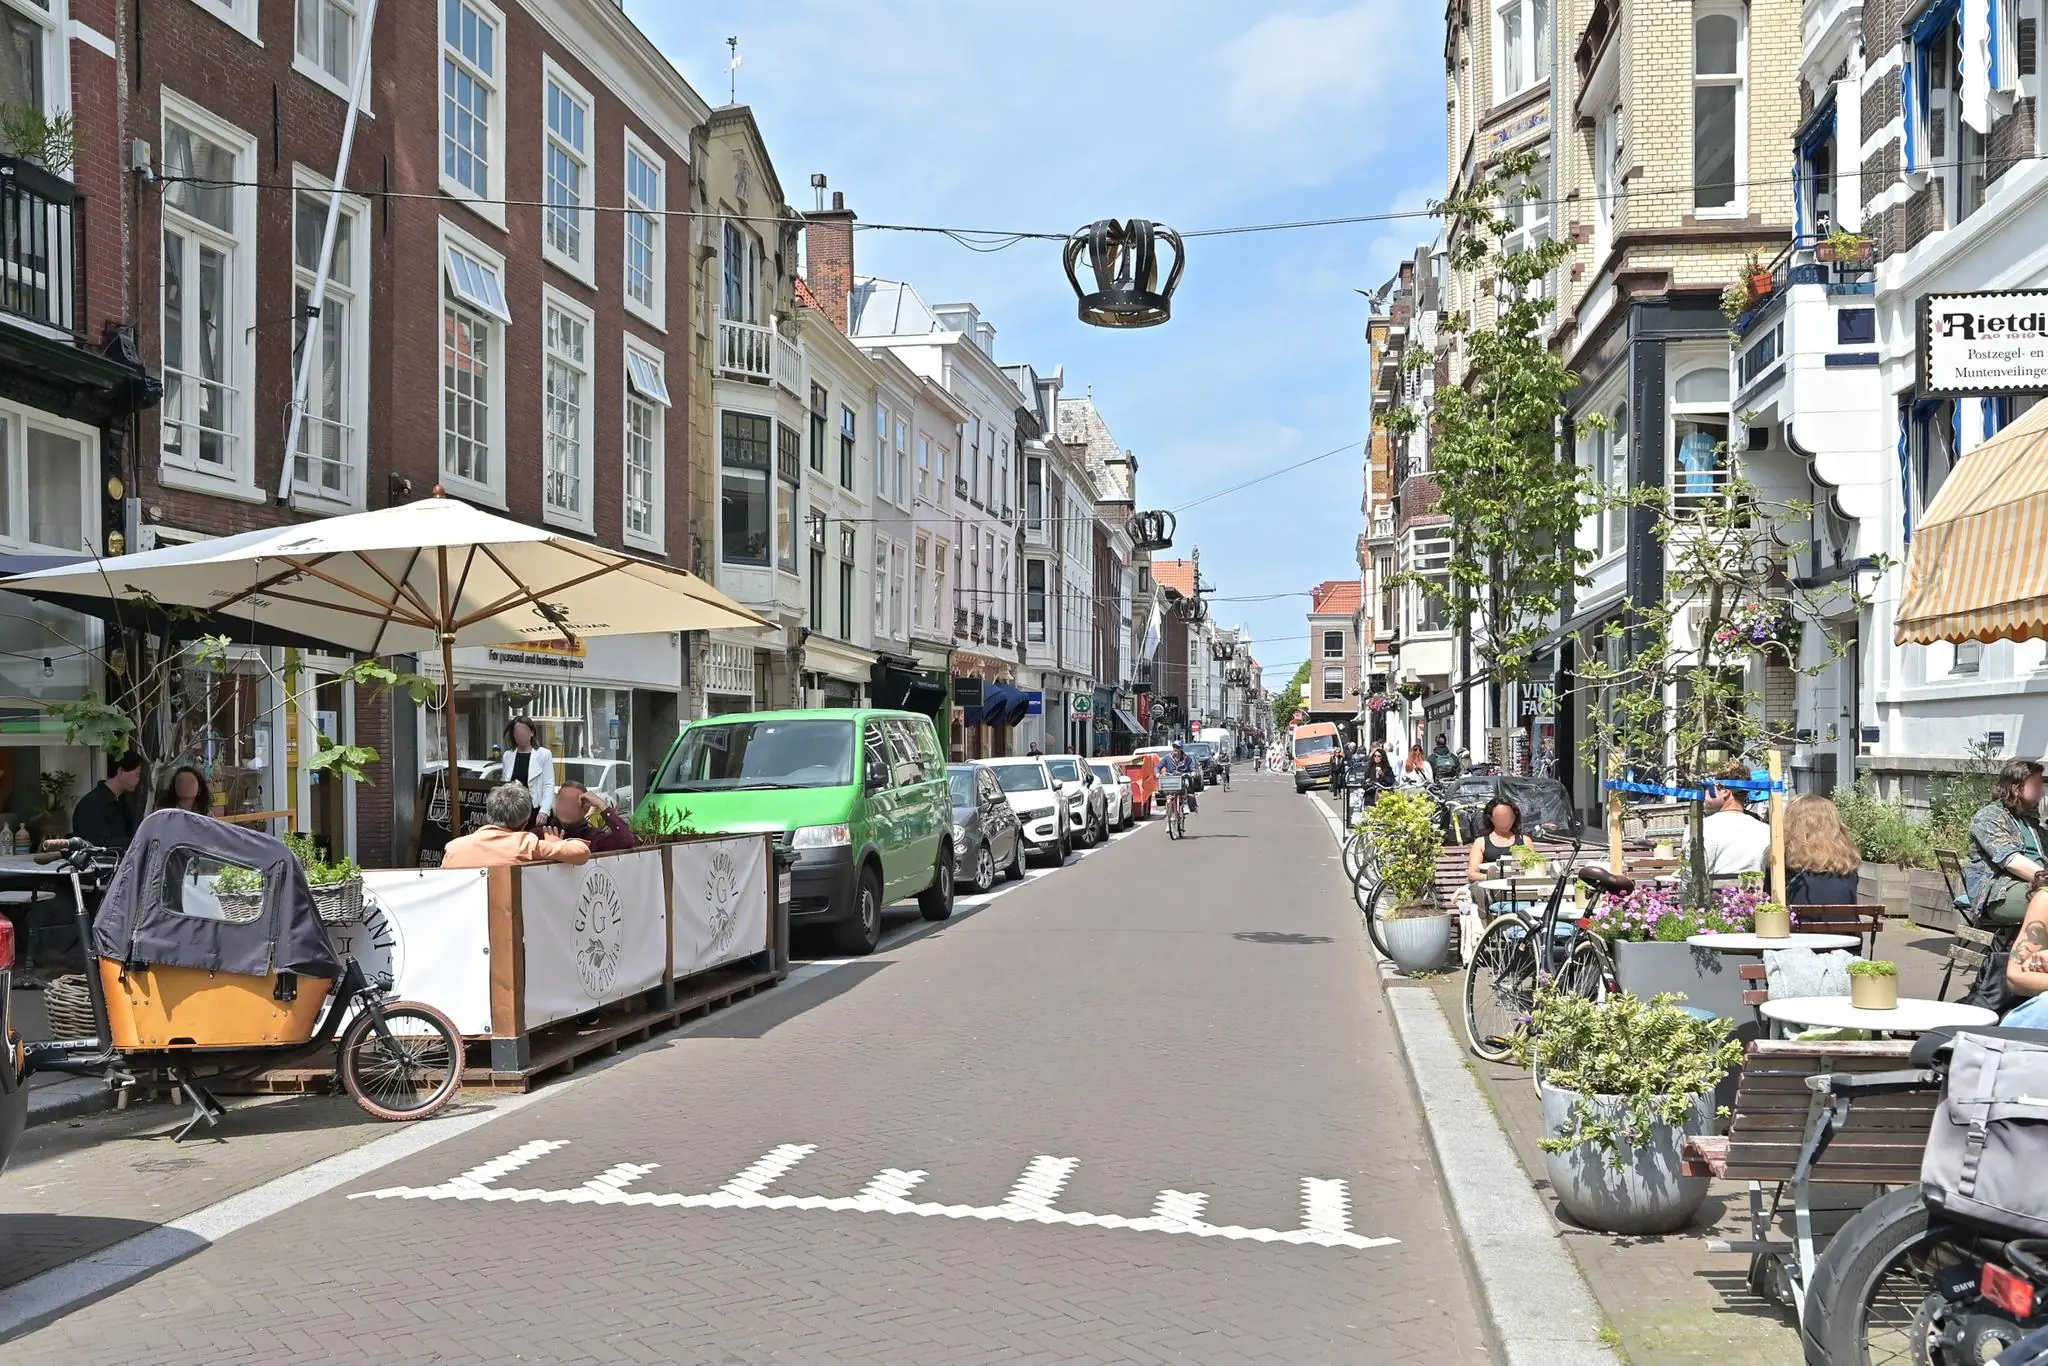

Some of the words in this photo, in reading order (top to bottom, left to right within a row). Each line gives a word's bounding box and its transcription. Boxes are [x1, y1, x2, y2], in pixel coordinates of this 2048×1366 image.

[1968, 347, 2025, 362] Postzegel-
[2030, 349, 2044, 358] en
[1955, 365, 2048, 379] Muntenveilinge
[500, 652, 524, 664] personal
[525, 654, 536, 664] and
[537, 655, 558, 666] business
[717, 877, 727, 903] G
[575, 873, 621, 932] GIAMBONINI
[593, 901, 606, 933] G
[1952, 1281, 1976, 1293] BMW
